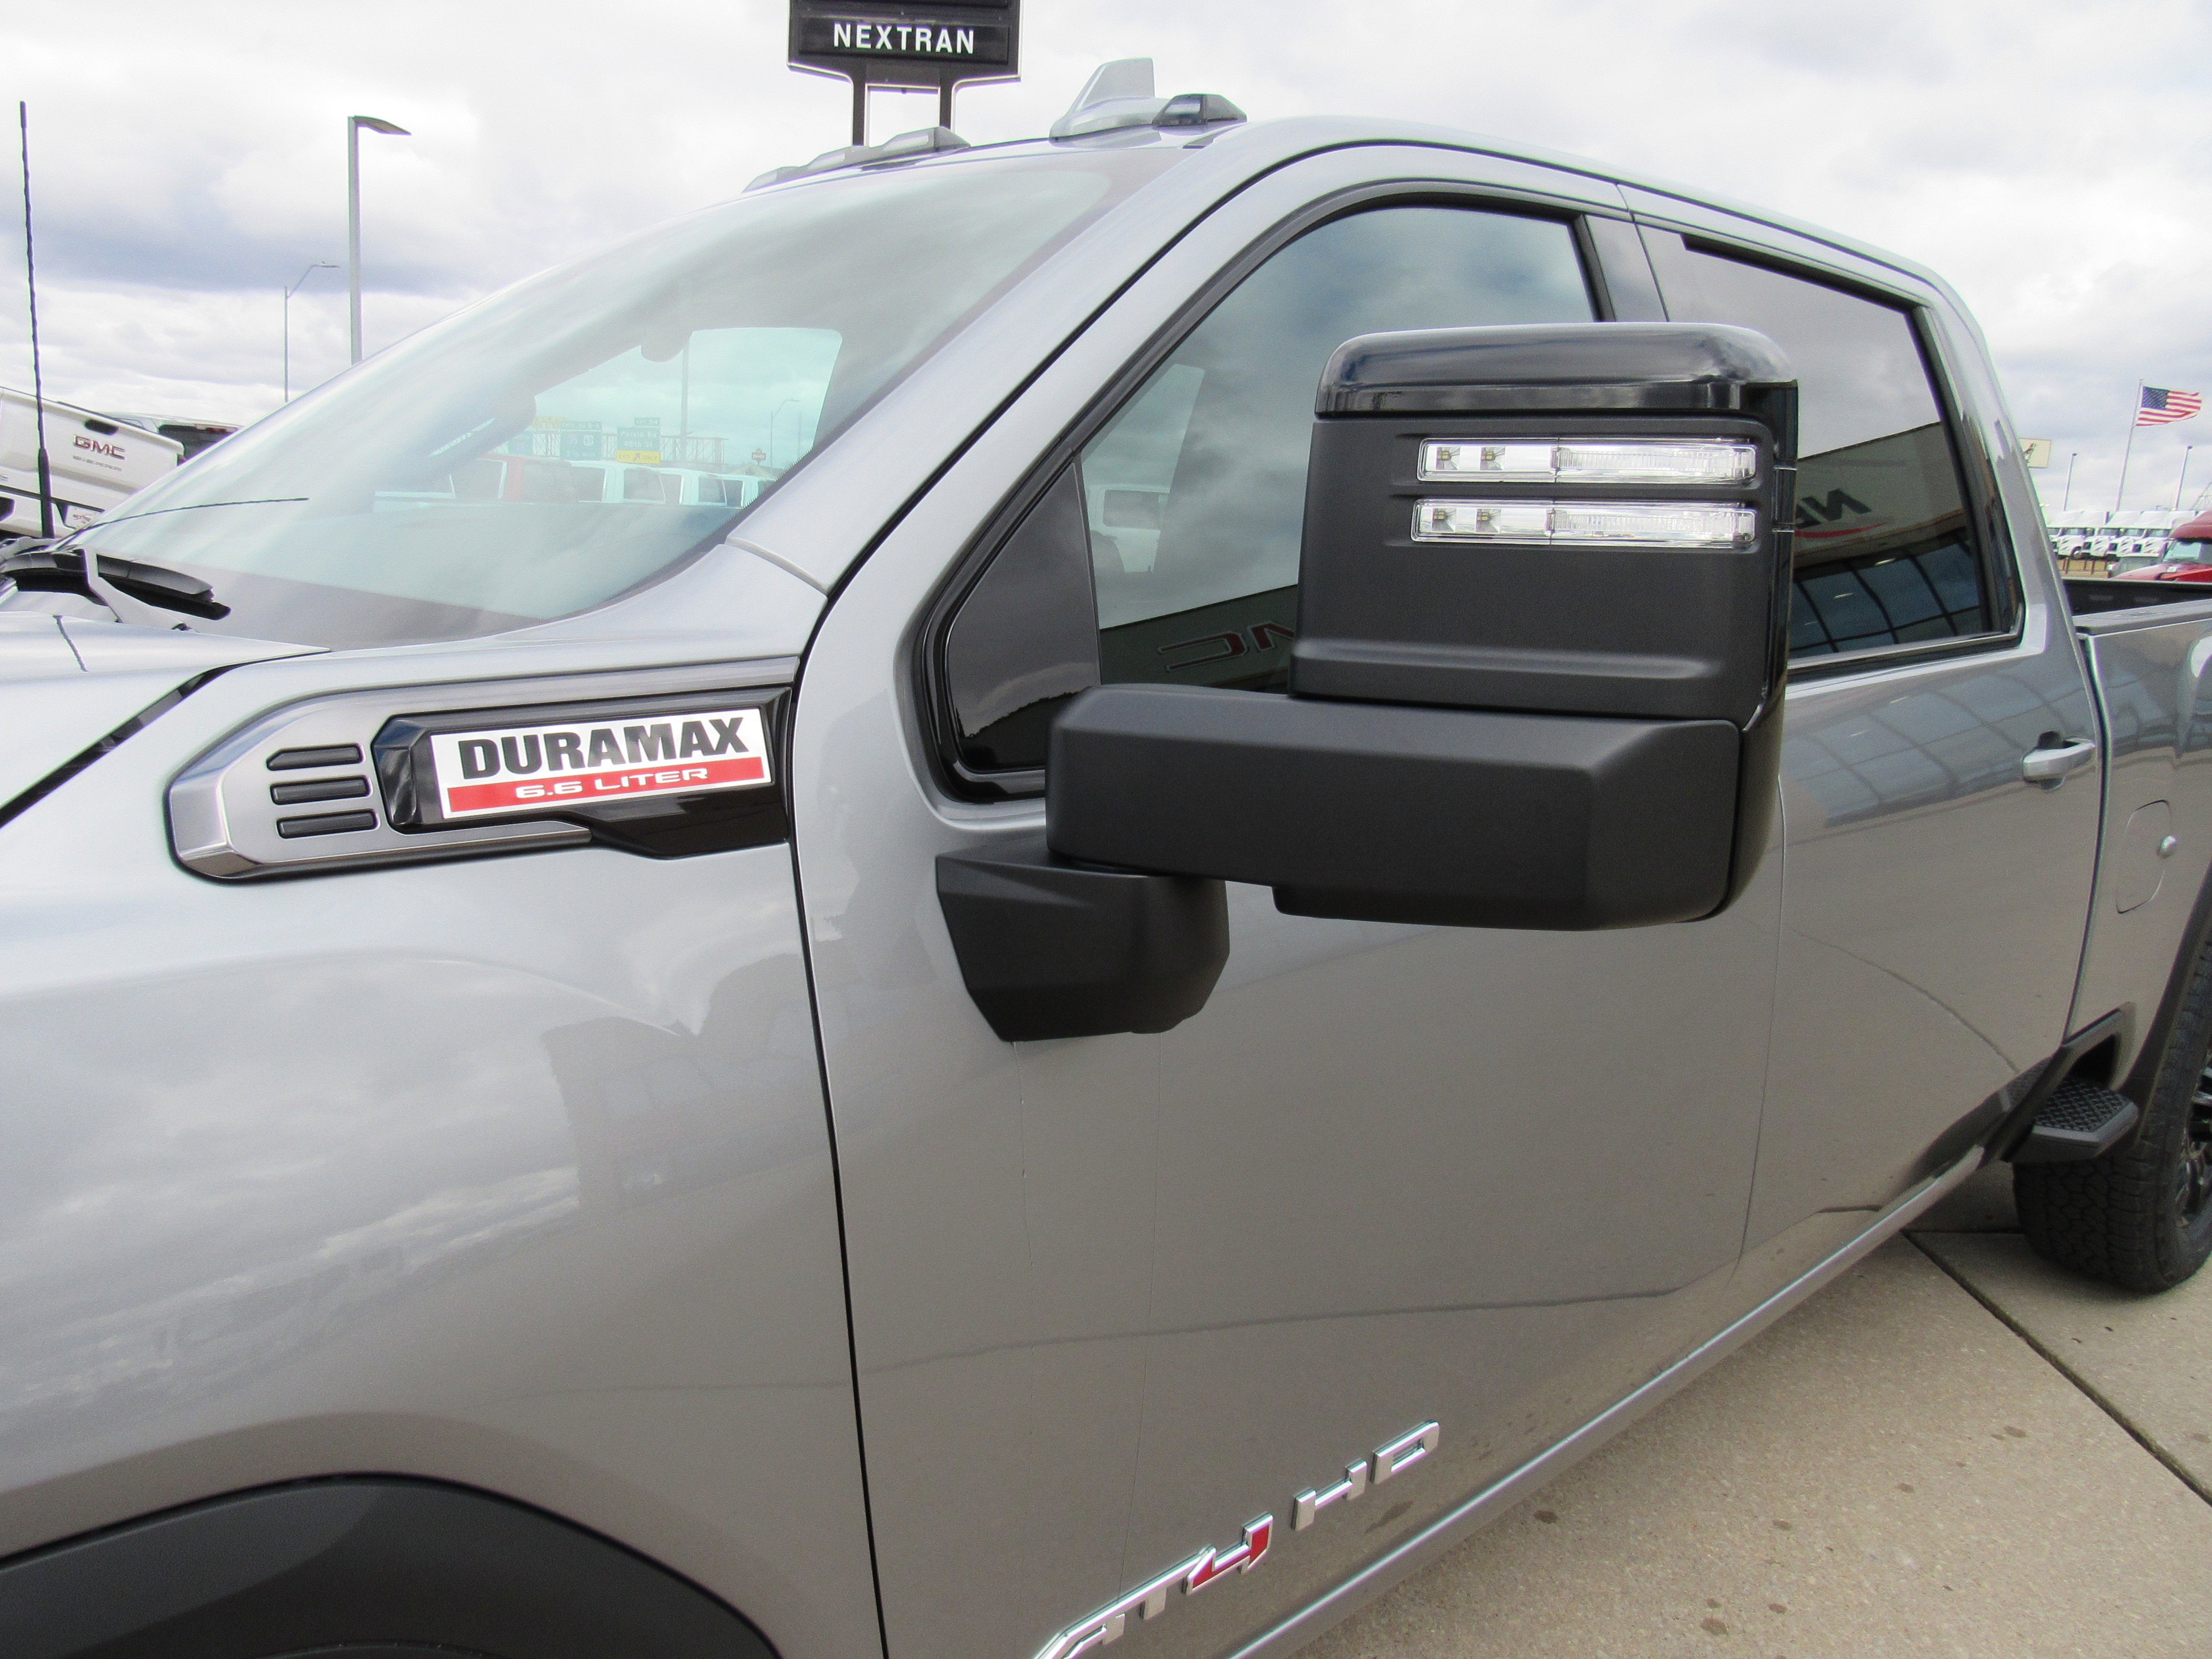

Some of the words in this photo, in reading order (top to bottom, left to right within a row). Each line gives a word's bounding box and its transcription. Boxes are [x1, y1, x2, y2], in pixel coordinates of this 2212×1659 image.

[833, 23, 974, 54] NEXTRAN
[73, 434, 125, 460] GMC
[458, 717, 748, 779] DURAMAX
[516, 781, 582, 799] 6.6
[596, 768, 708, 790] LITER
